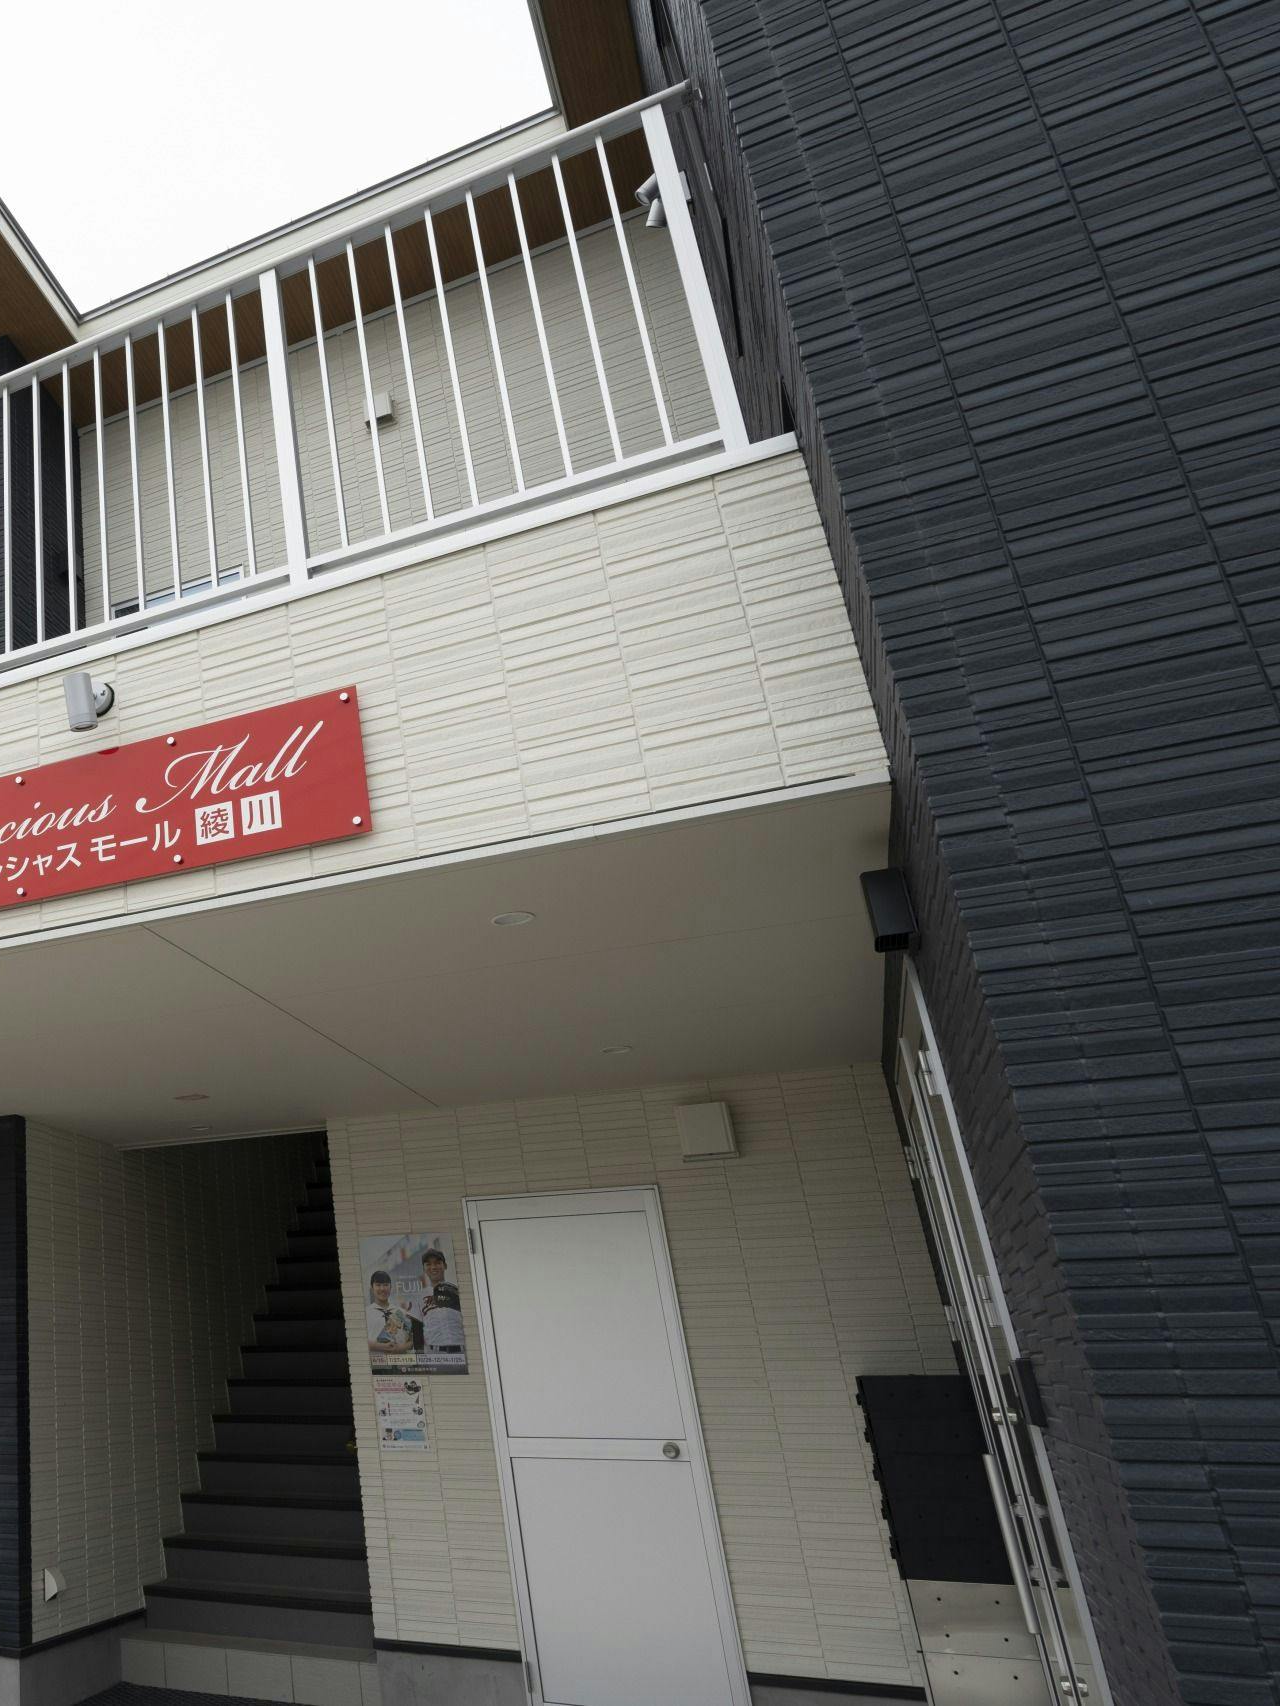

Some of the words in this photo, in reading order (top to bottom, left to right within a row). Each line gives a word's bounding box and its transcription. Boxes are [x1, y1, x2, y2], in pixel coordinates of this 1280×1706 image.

[136, 721, 323, 814] Mall
[90, 821, 181, 862] モール
[197, 795, 280, 842] 綾川
